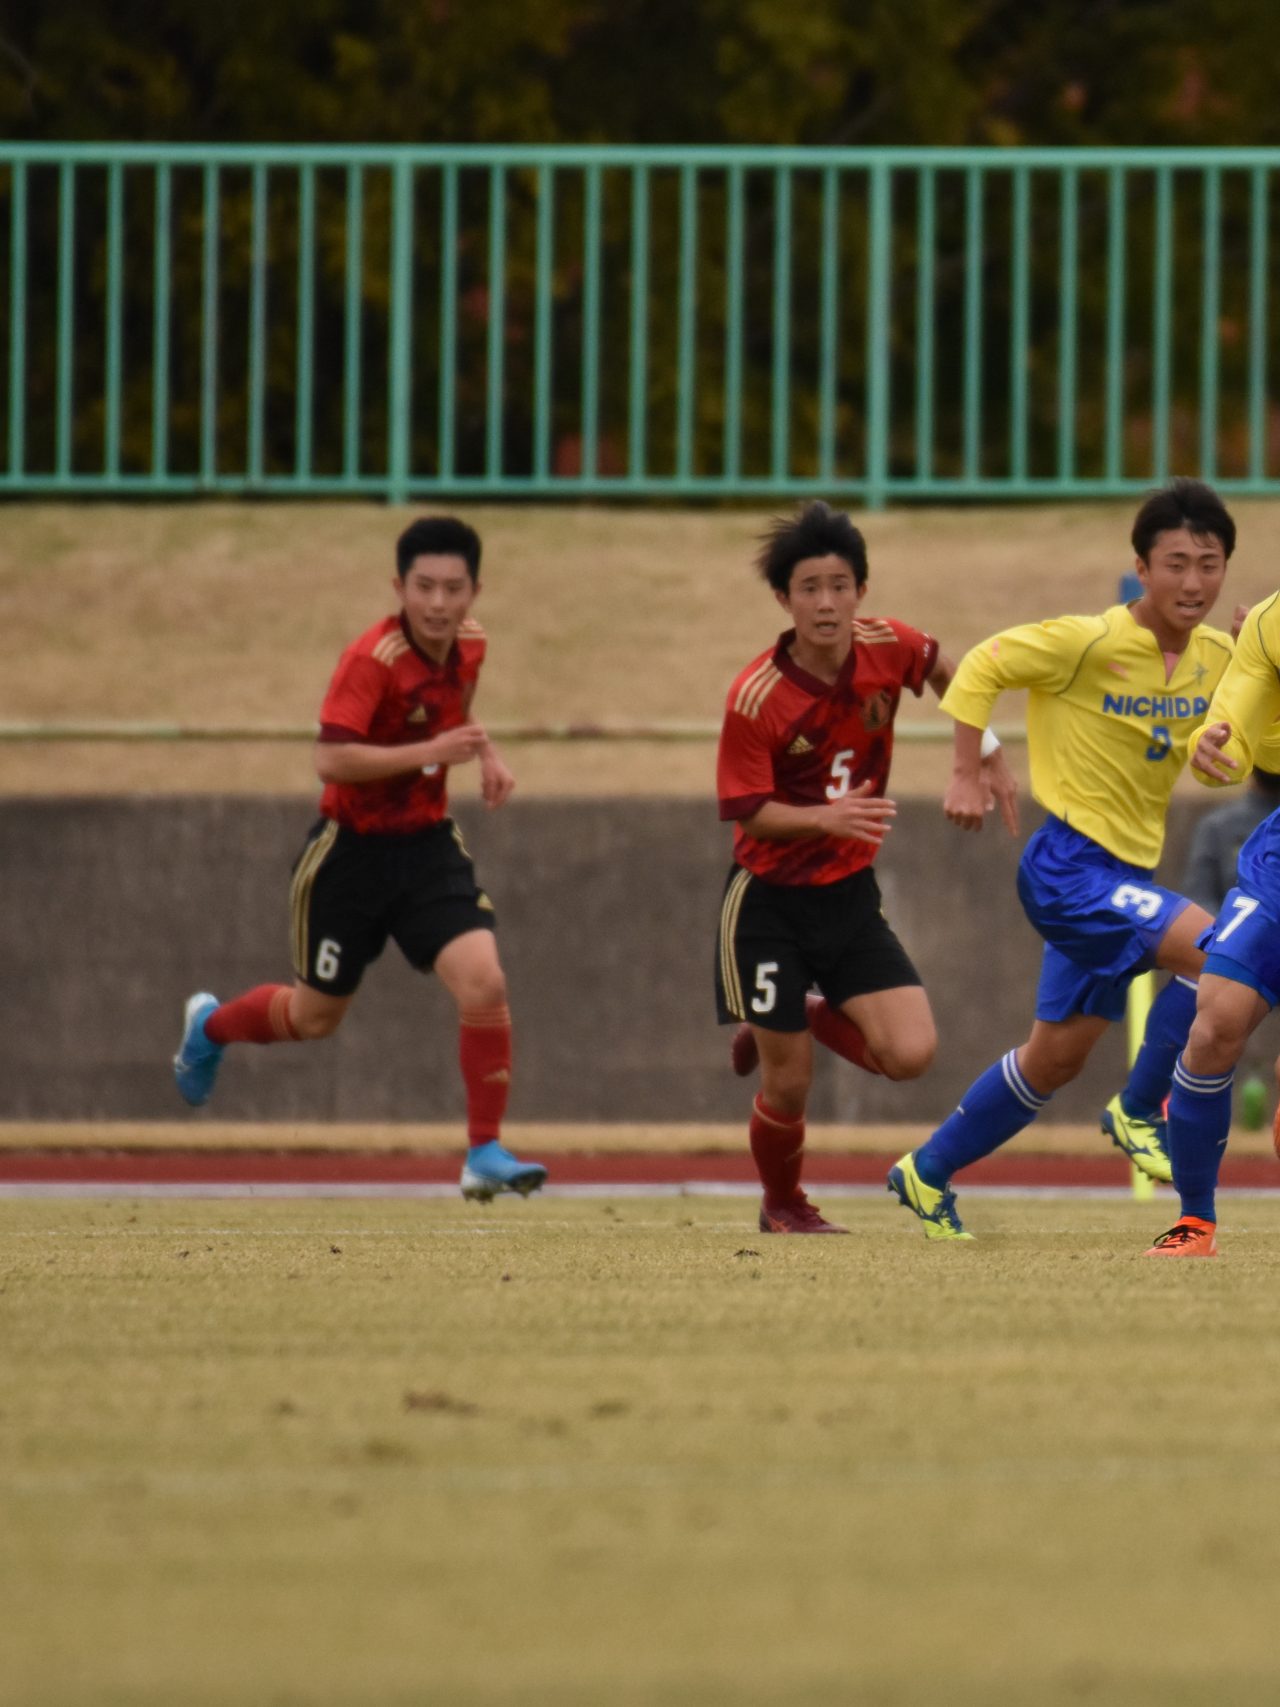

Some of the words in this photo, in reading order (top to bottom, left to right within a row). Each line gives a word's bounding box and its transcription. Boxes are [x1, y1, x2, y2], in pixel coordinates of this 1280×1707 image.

[1103, 692, 1213, 718] NICHIDA
[825, 750, 854, 799] 5
[1111, 883, 1163, 919] 3
[1216, 896, 1260, 942] 7
[316, 938, 341, 980] 6
[751, 961, 779, 1013] 5
